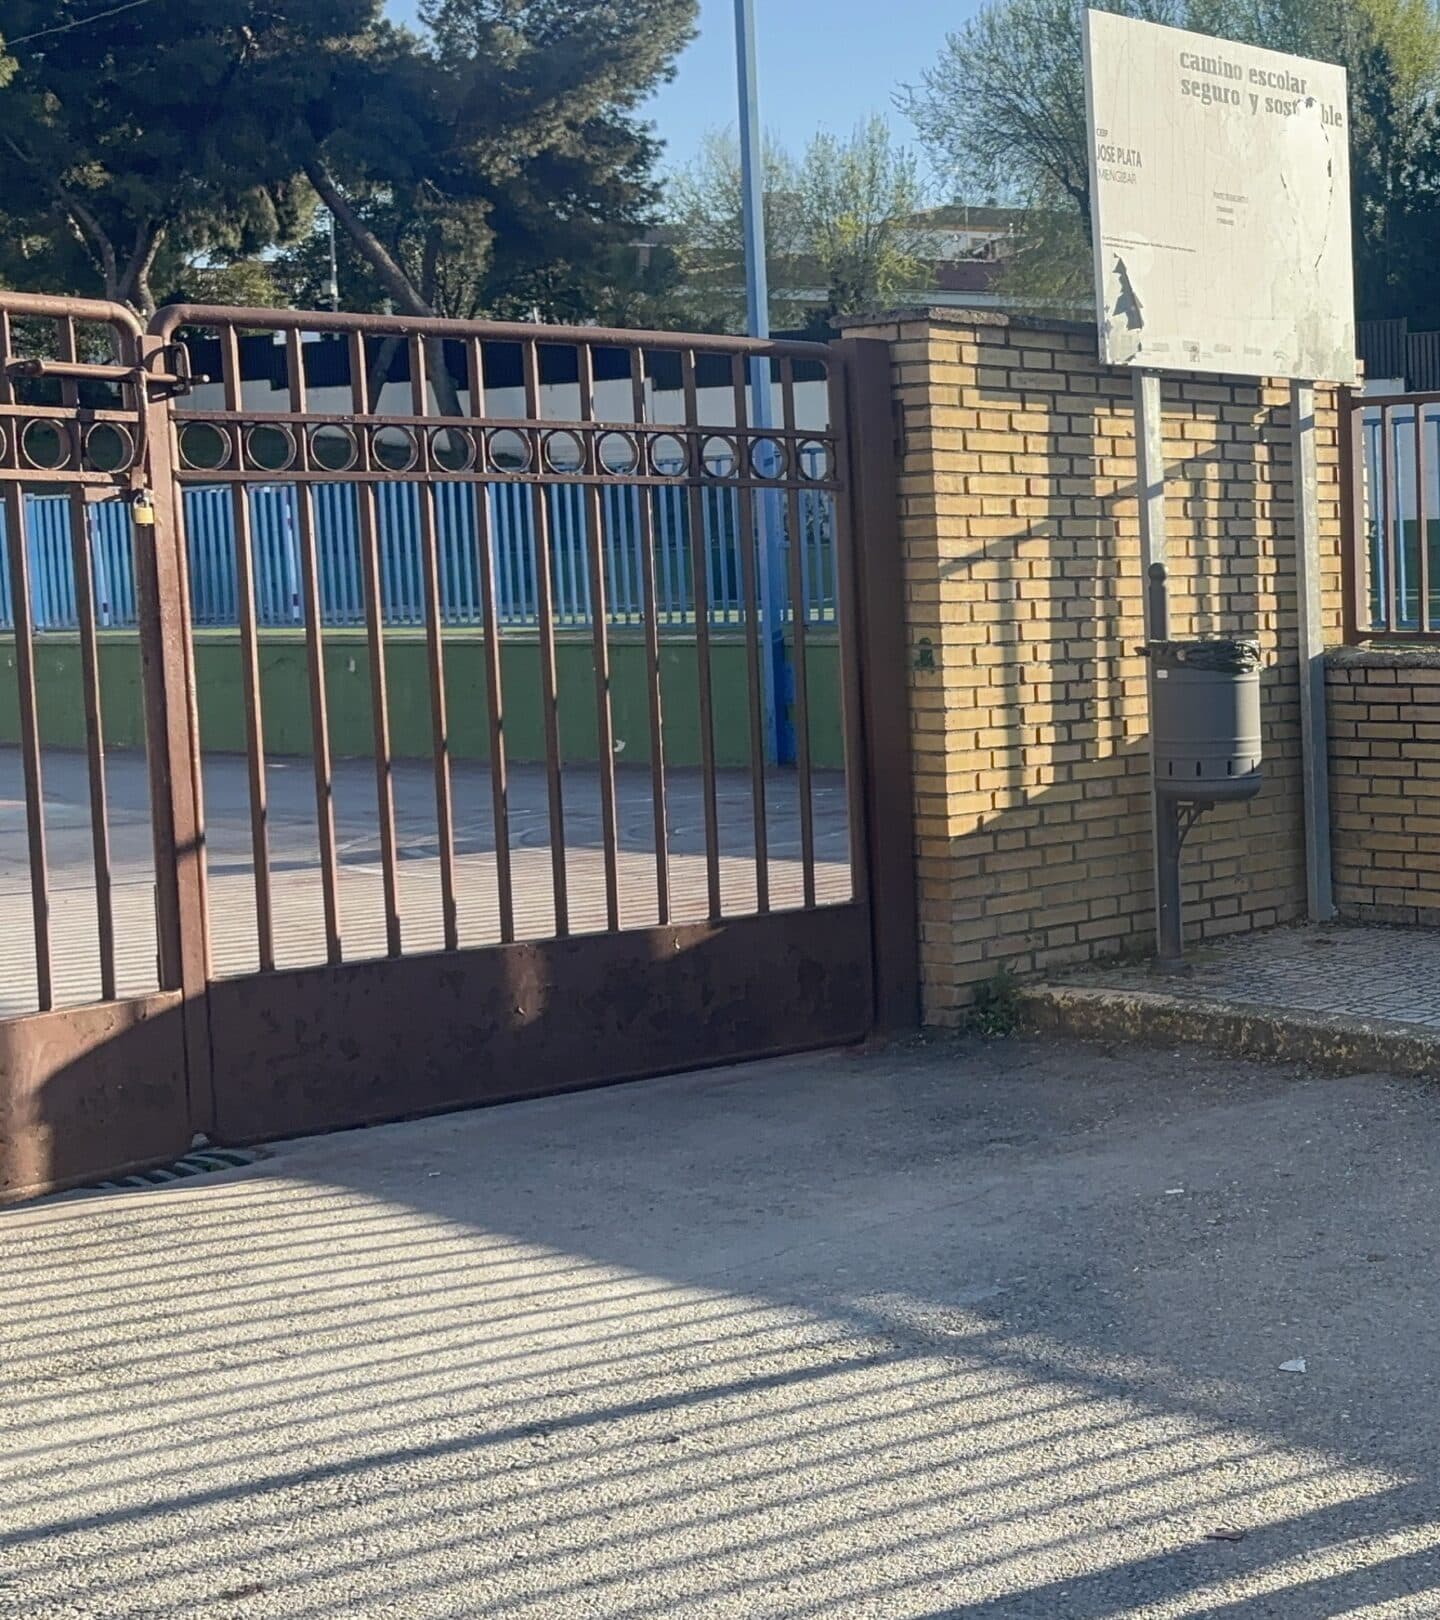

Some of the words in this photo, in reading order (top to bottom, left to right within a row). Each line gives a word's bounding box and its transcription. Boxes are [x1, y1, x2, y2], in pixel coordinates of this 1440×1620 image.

[1179, 51, 1243, 81] camino
[1248, 66, 1307, 95] escolar
[1181, 78, 1241, 106] seguro
[1248, 92, 1260, 115] y
[1117, 147, 1142, 168] PLATA
